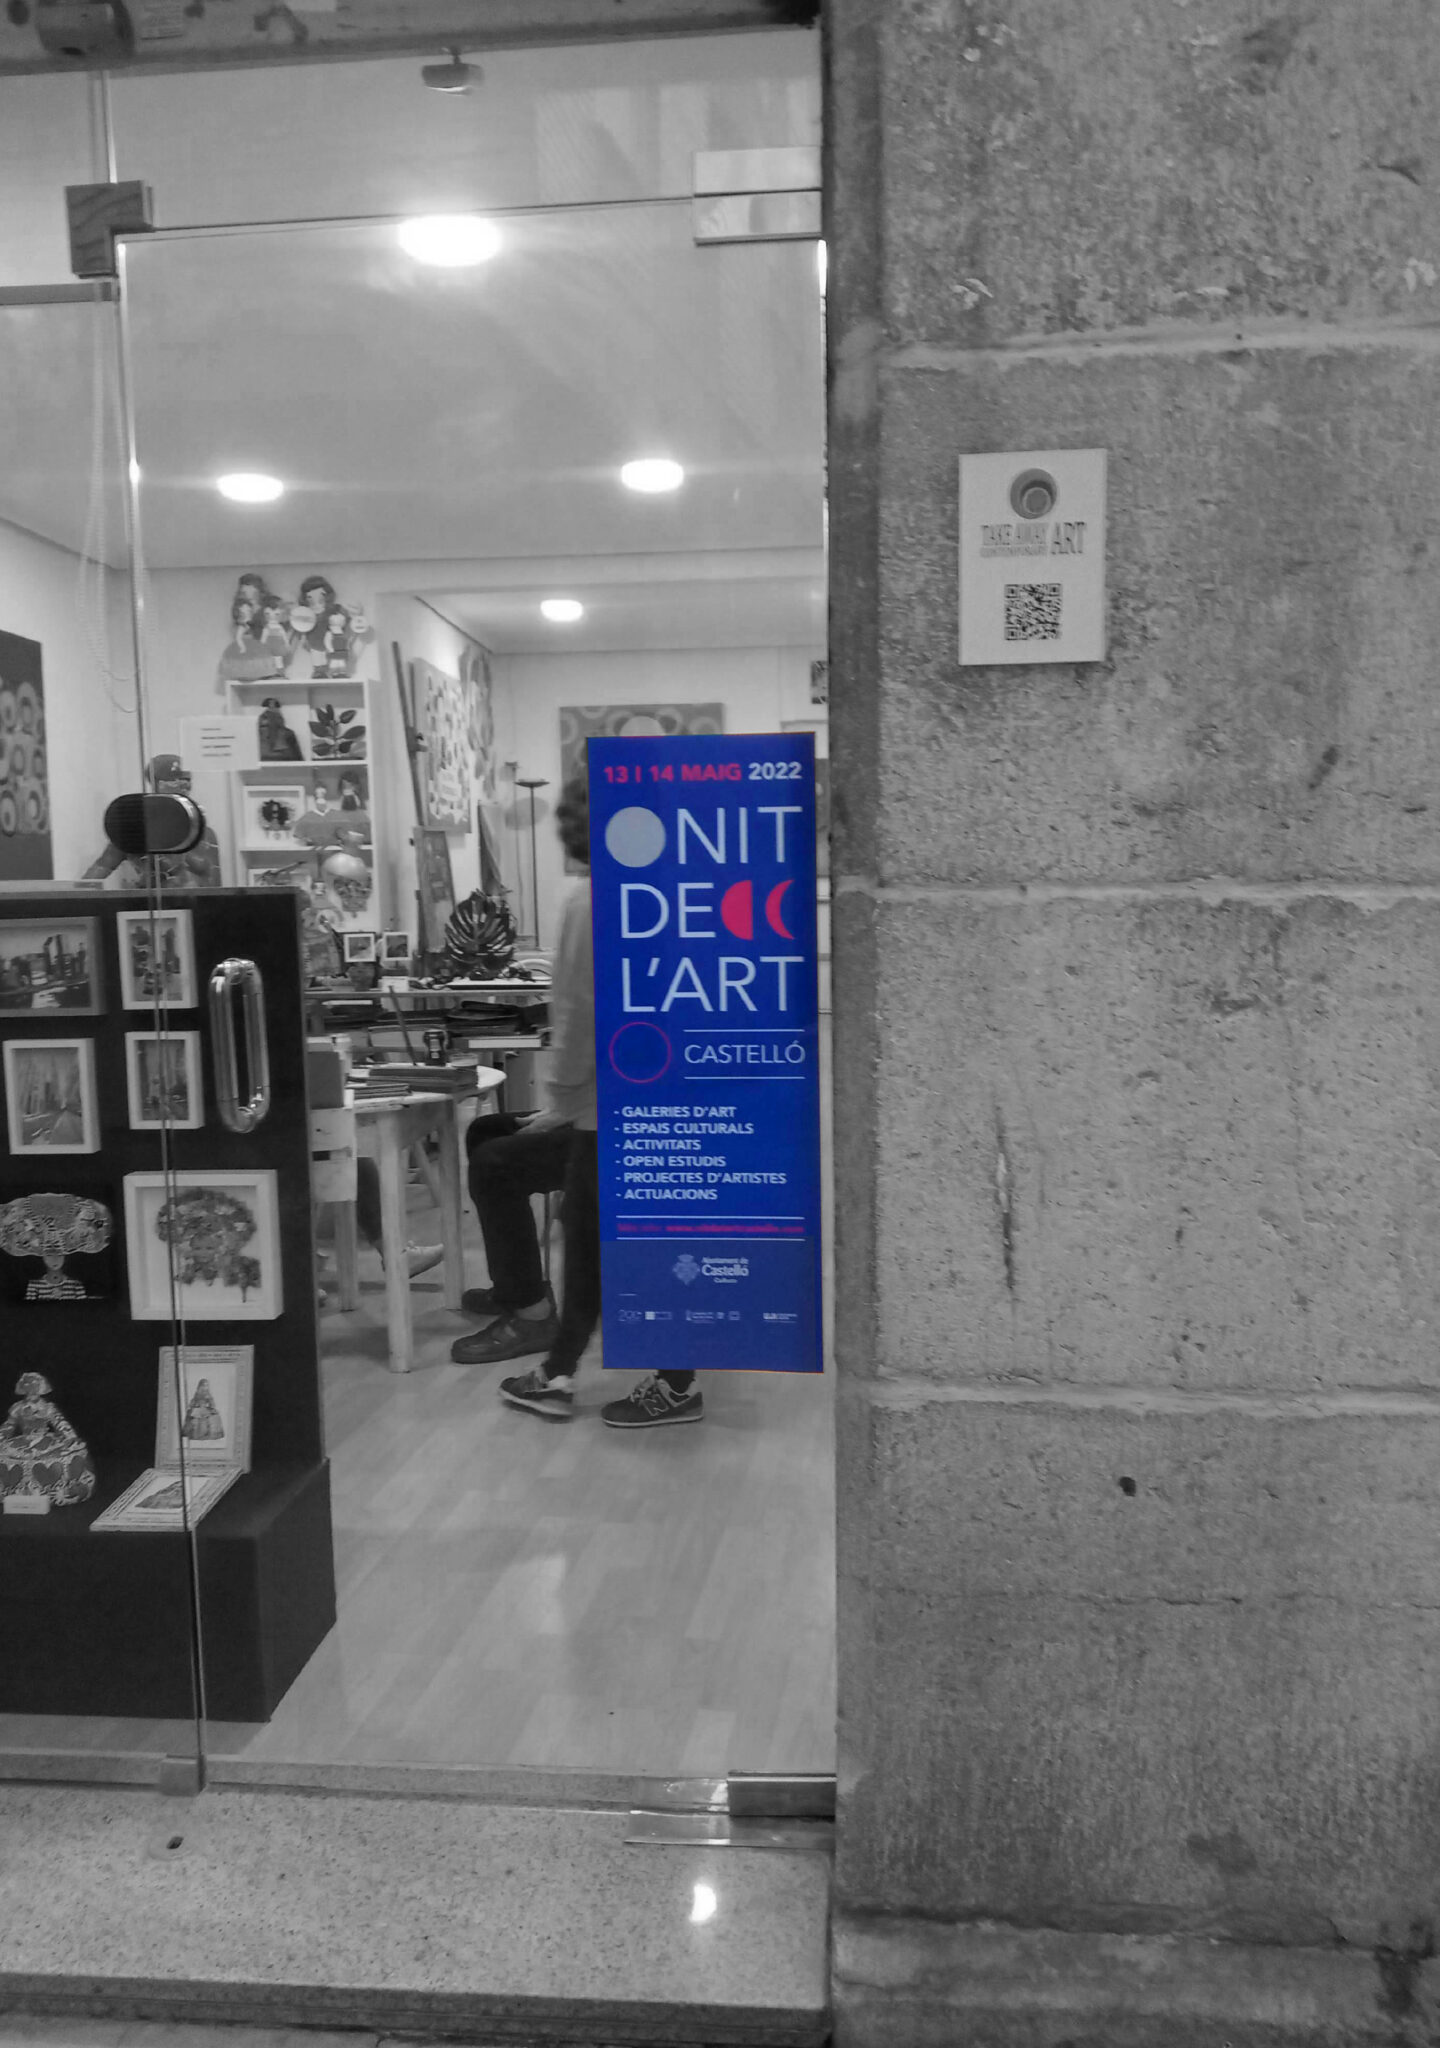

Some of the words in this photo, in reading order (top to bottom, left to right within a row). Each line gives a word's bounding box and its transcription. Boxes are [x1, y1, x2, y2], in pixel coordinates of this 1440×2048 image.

[1051, 521, 1086, 555] ART
[604, 766, 629, 784] 13
[650, 765, 674, 782] 14
[681, 763, 742, 781] MAIG
[748, 761, 803, 780] 2022
[677, 806, 803, 864] NIT
[620, 882, 716, 939] DE
[622, 956, 805, 1013] L'ART
[684, 1040, 806, 1064] CASTELLÓ
[621, 1106, 690, 1118] GALERIES
[693, 1106, 736, 1118] D'ART
[622, 1122, 670, 1134] ESPAIS
[673, 1122, 754, 1135] CULTURALS
[623, 1139, 701, 1151] ACTIVITATS
[623, 1155, 664, 1167] OPEN
[668, 1155, 726, 1168] ESTUDIS
[623, 1172, 703, 1184] PROJECTES
[706, 1172, 787, 1185] D'ARTISTES
[624, 1188, 718, 1201] ACTUACIONS
[701, 1264, 750, 1277] Castelló
